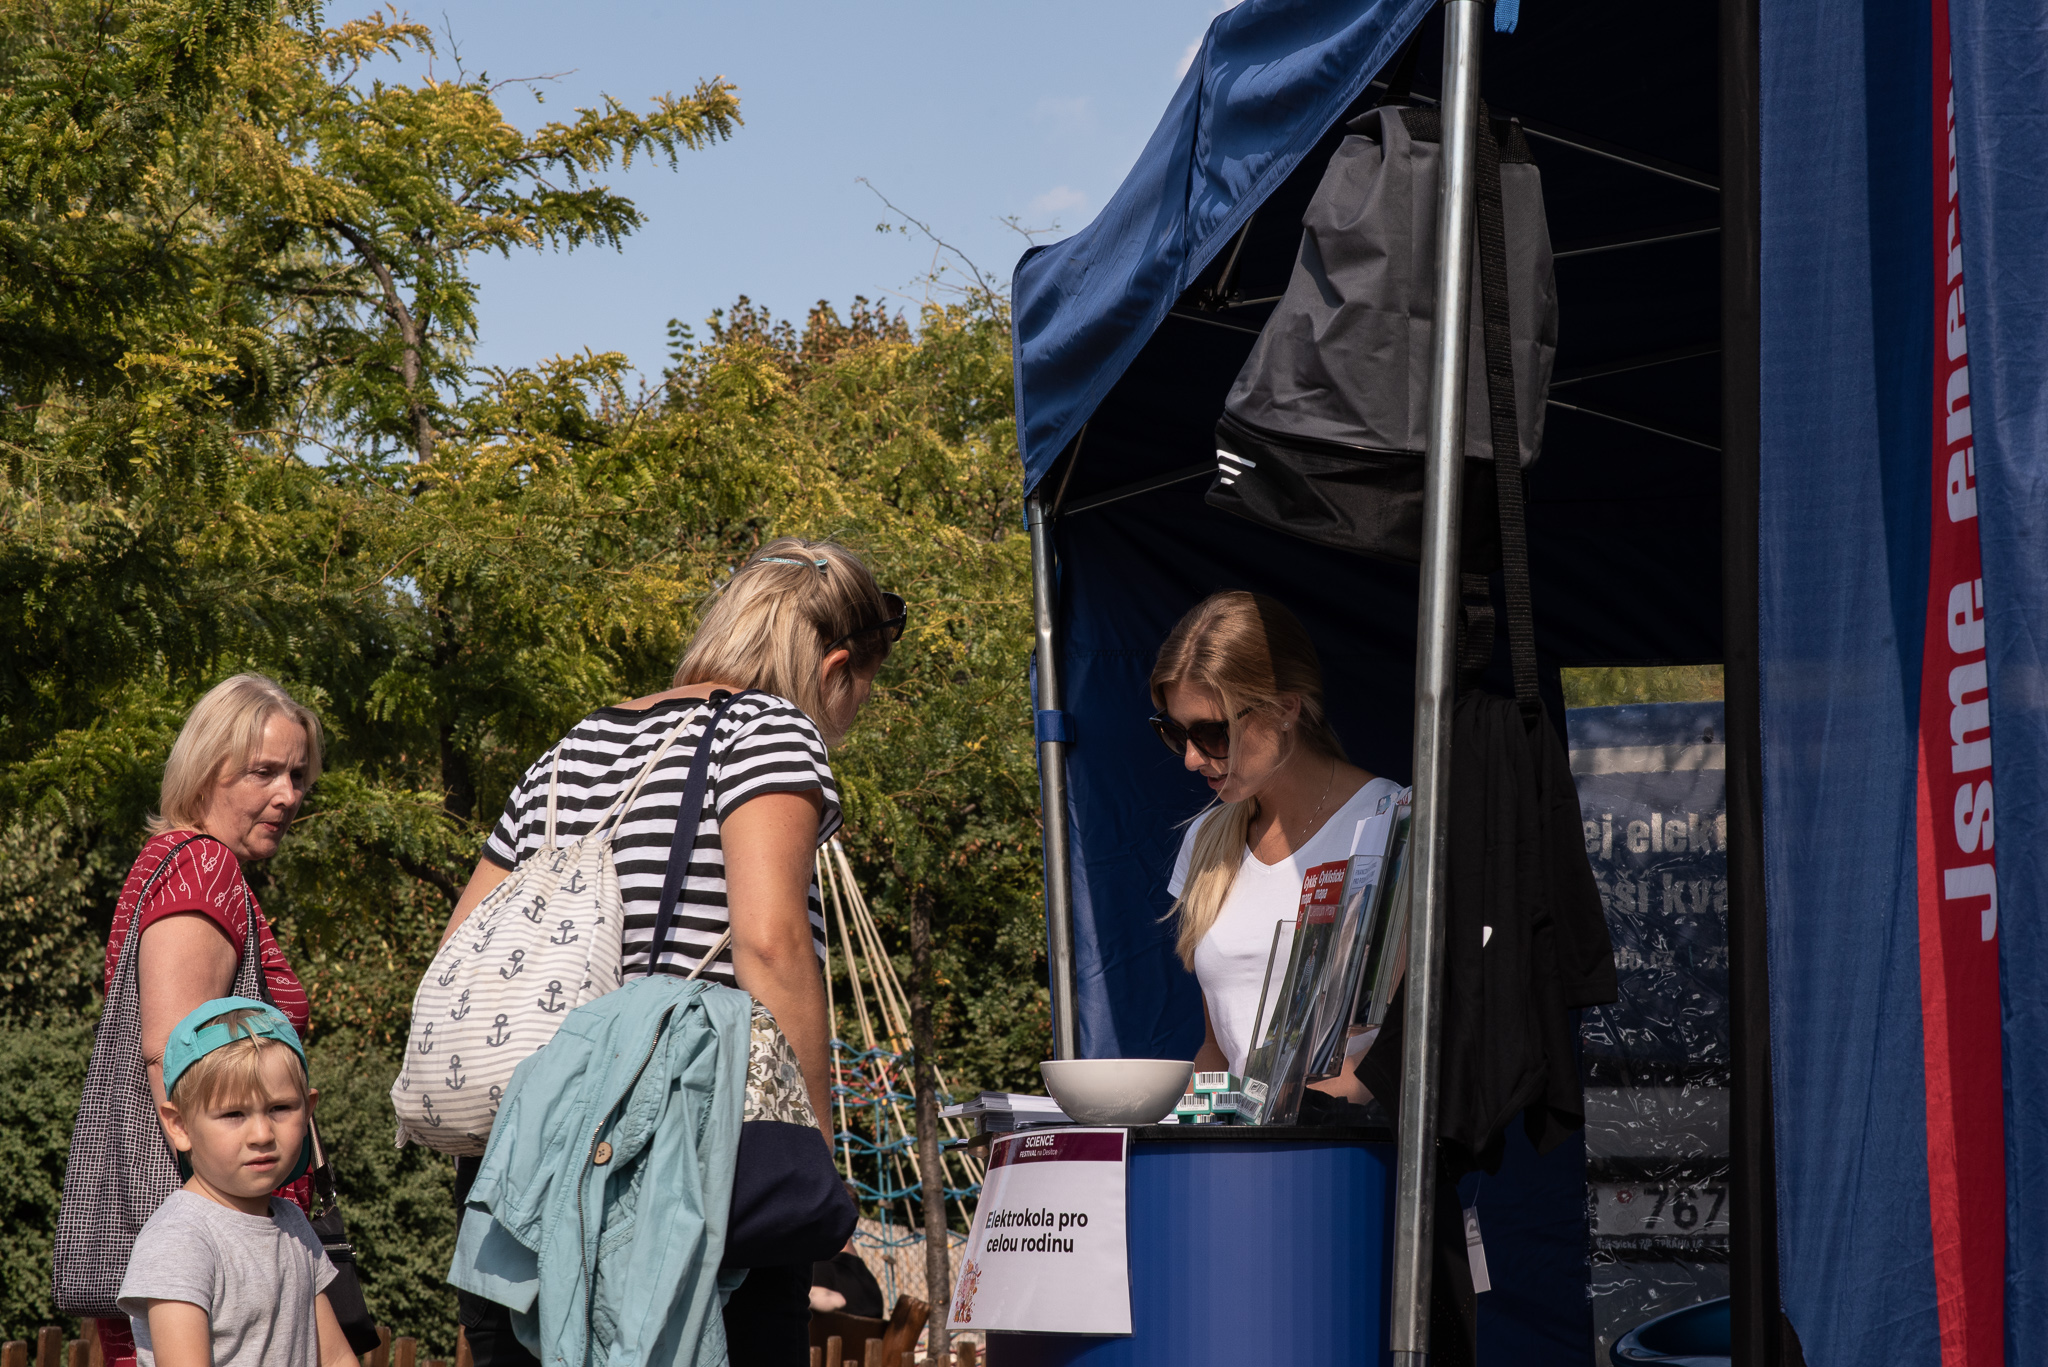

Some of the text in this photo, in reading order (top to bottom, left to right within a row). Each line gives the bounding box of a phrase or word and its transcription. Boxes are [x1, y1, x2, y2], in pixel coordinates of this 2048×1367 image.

[1944, 578, 1998, 941] Jsme
[1304, 873, 1318, 892] Cyklis
[1318, 868, 1346, 887] Cyklistická
[1314, 888, 1328, 902] mapa
[1025, 1135, 1055, 1148] SCIENCE
[1019, 1149, 1037, 1158] FESTIVAL
[985, 1208, 1089, 1231] Elektrokola pro
[986, 1232, 1074, 1253] celou rodinu
